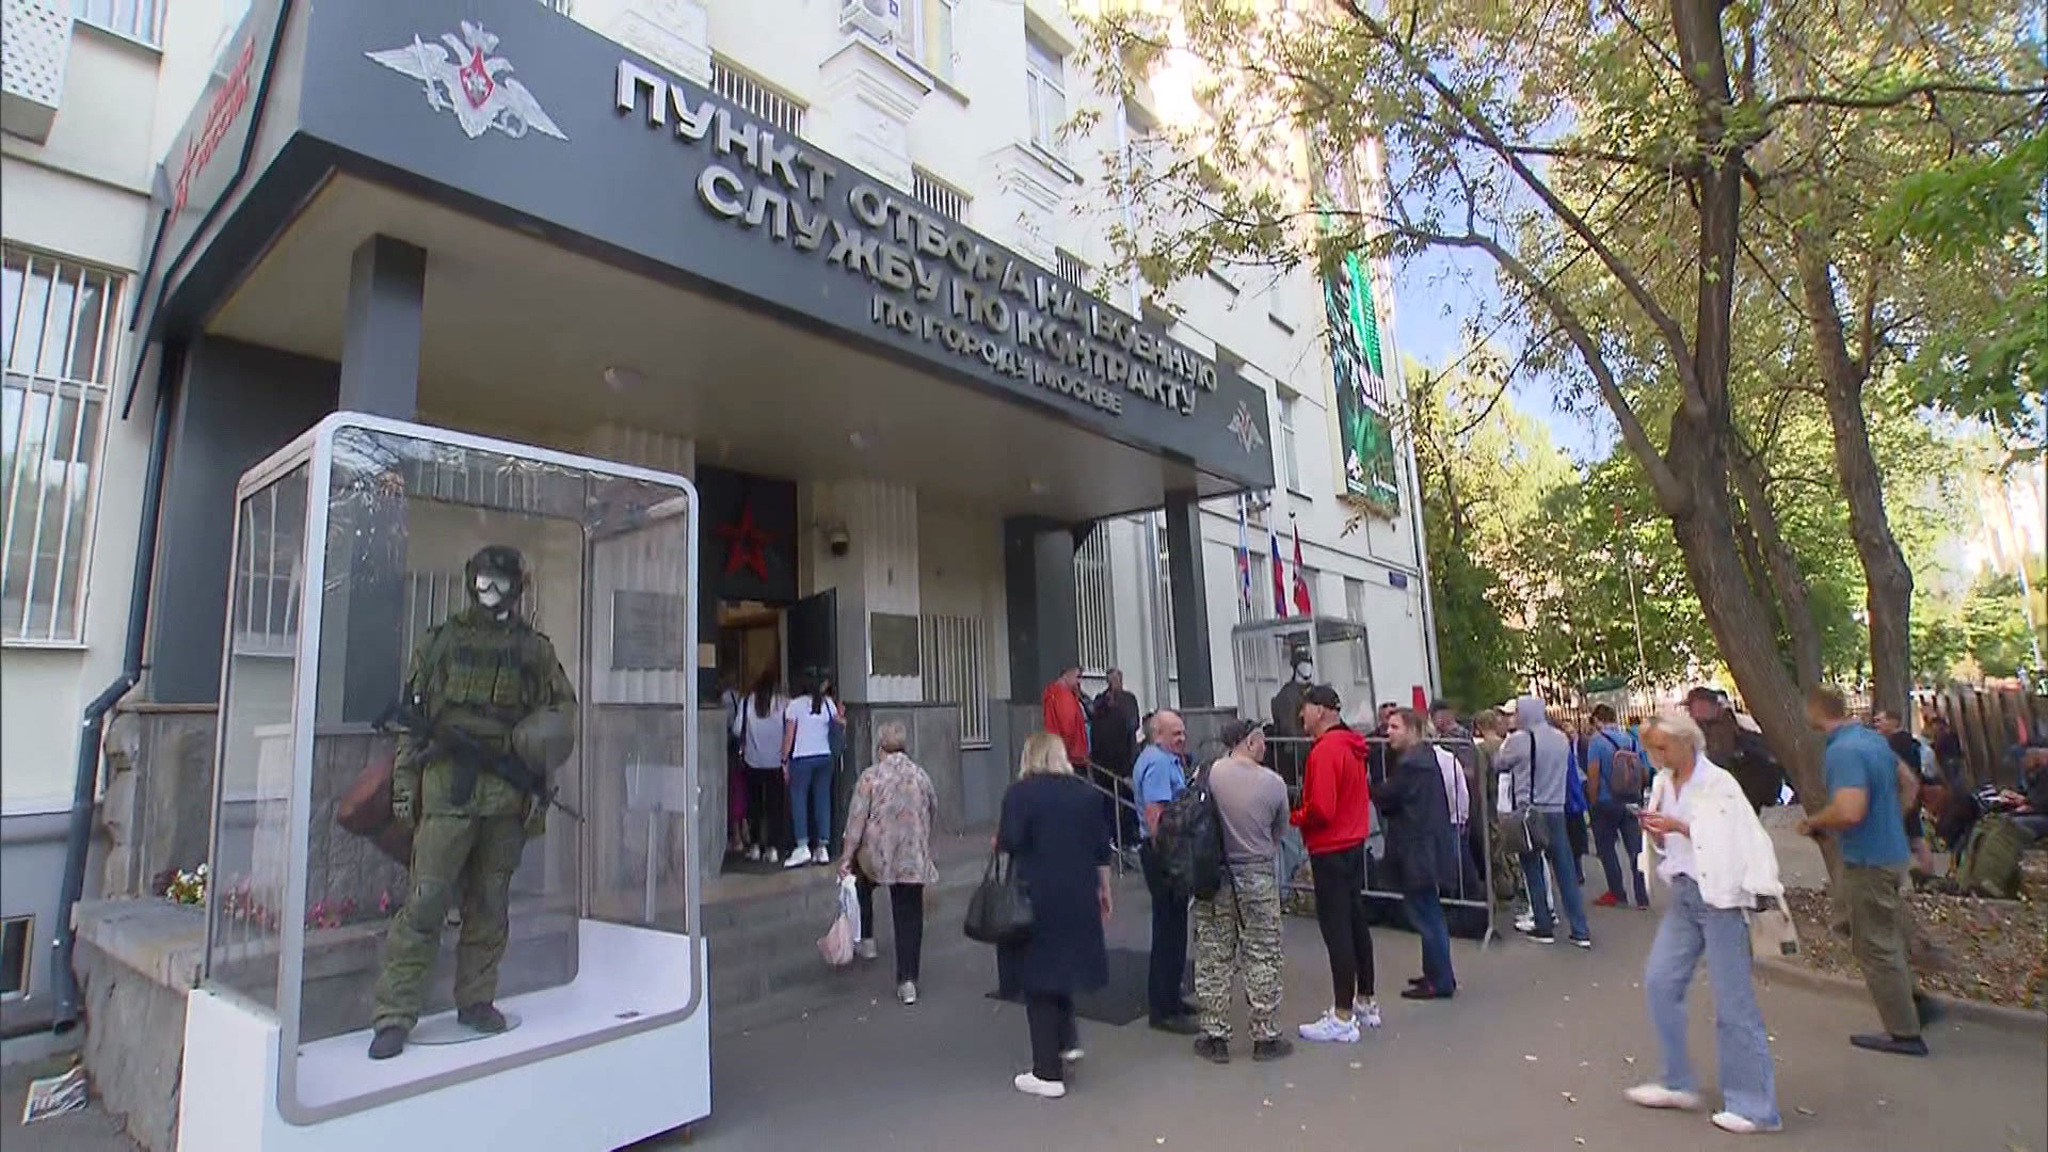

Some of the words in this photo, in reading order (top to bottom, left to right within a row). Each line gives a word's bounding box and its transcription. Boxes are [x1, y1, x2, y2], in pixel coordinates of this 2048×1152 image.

[617, 59, 836, 201] ПУНКТ
[848, 184, 1029, 300] ОТБОРА
[1035, 275, 1081, 322] НА
[1089, 304, 1217, 393] ВОЕННУЮ
[697, 165, 941, 301] СЛУЖБУ
[951, 277, 1010, 334] ПО
[1015, 309, 1196, 416] КОНТРАКТУ
[872, 294, 916, 333] ПО
[922, 315, 1030, 377] ГОРОДУ
[1033, 360, 1122, 416] МОСКВЕ
